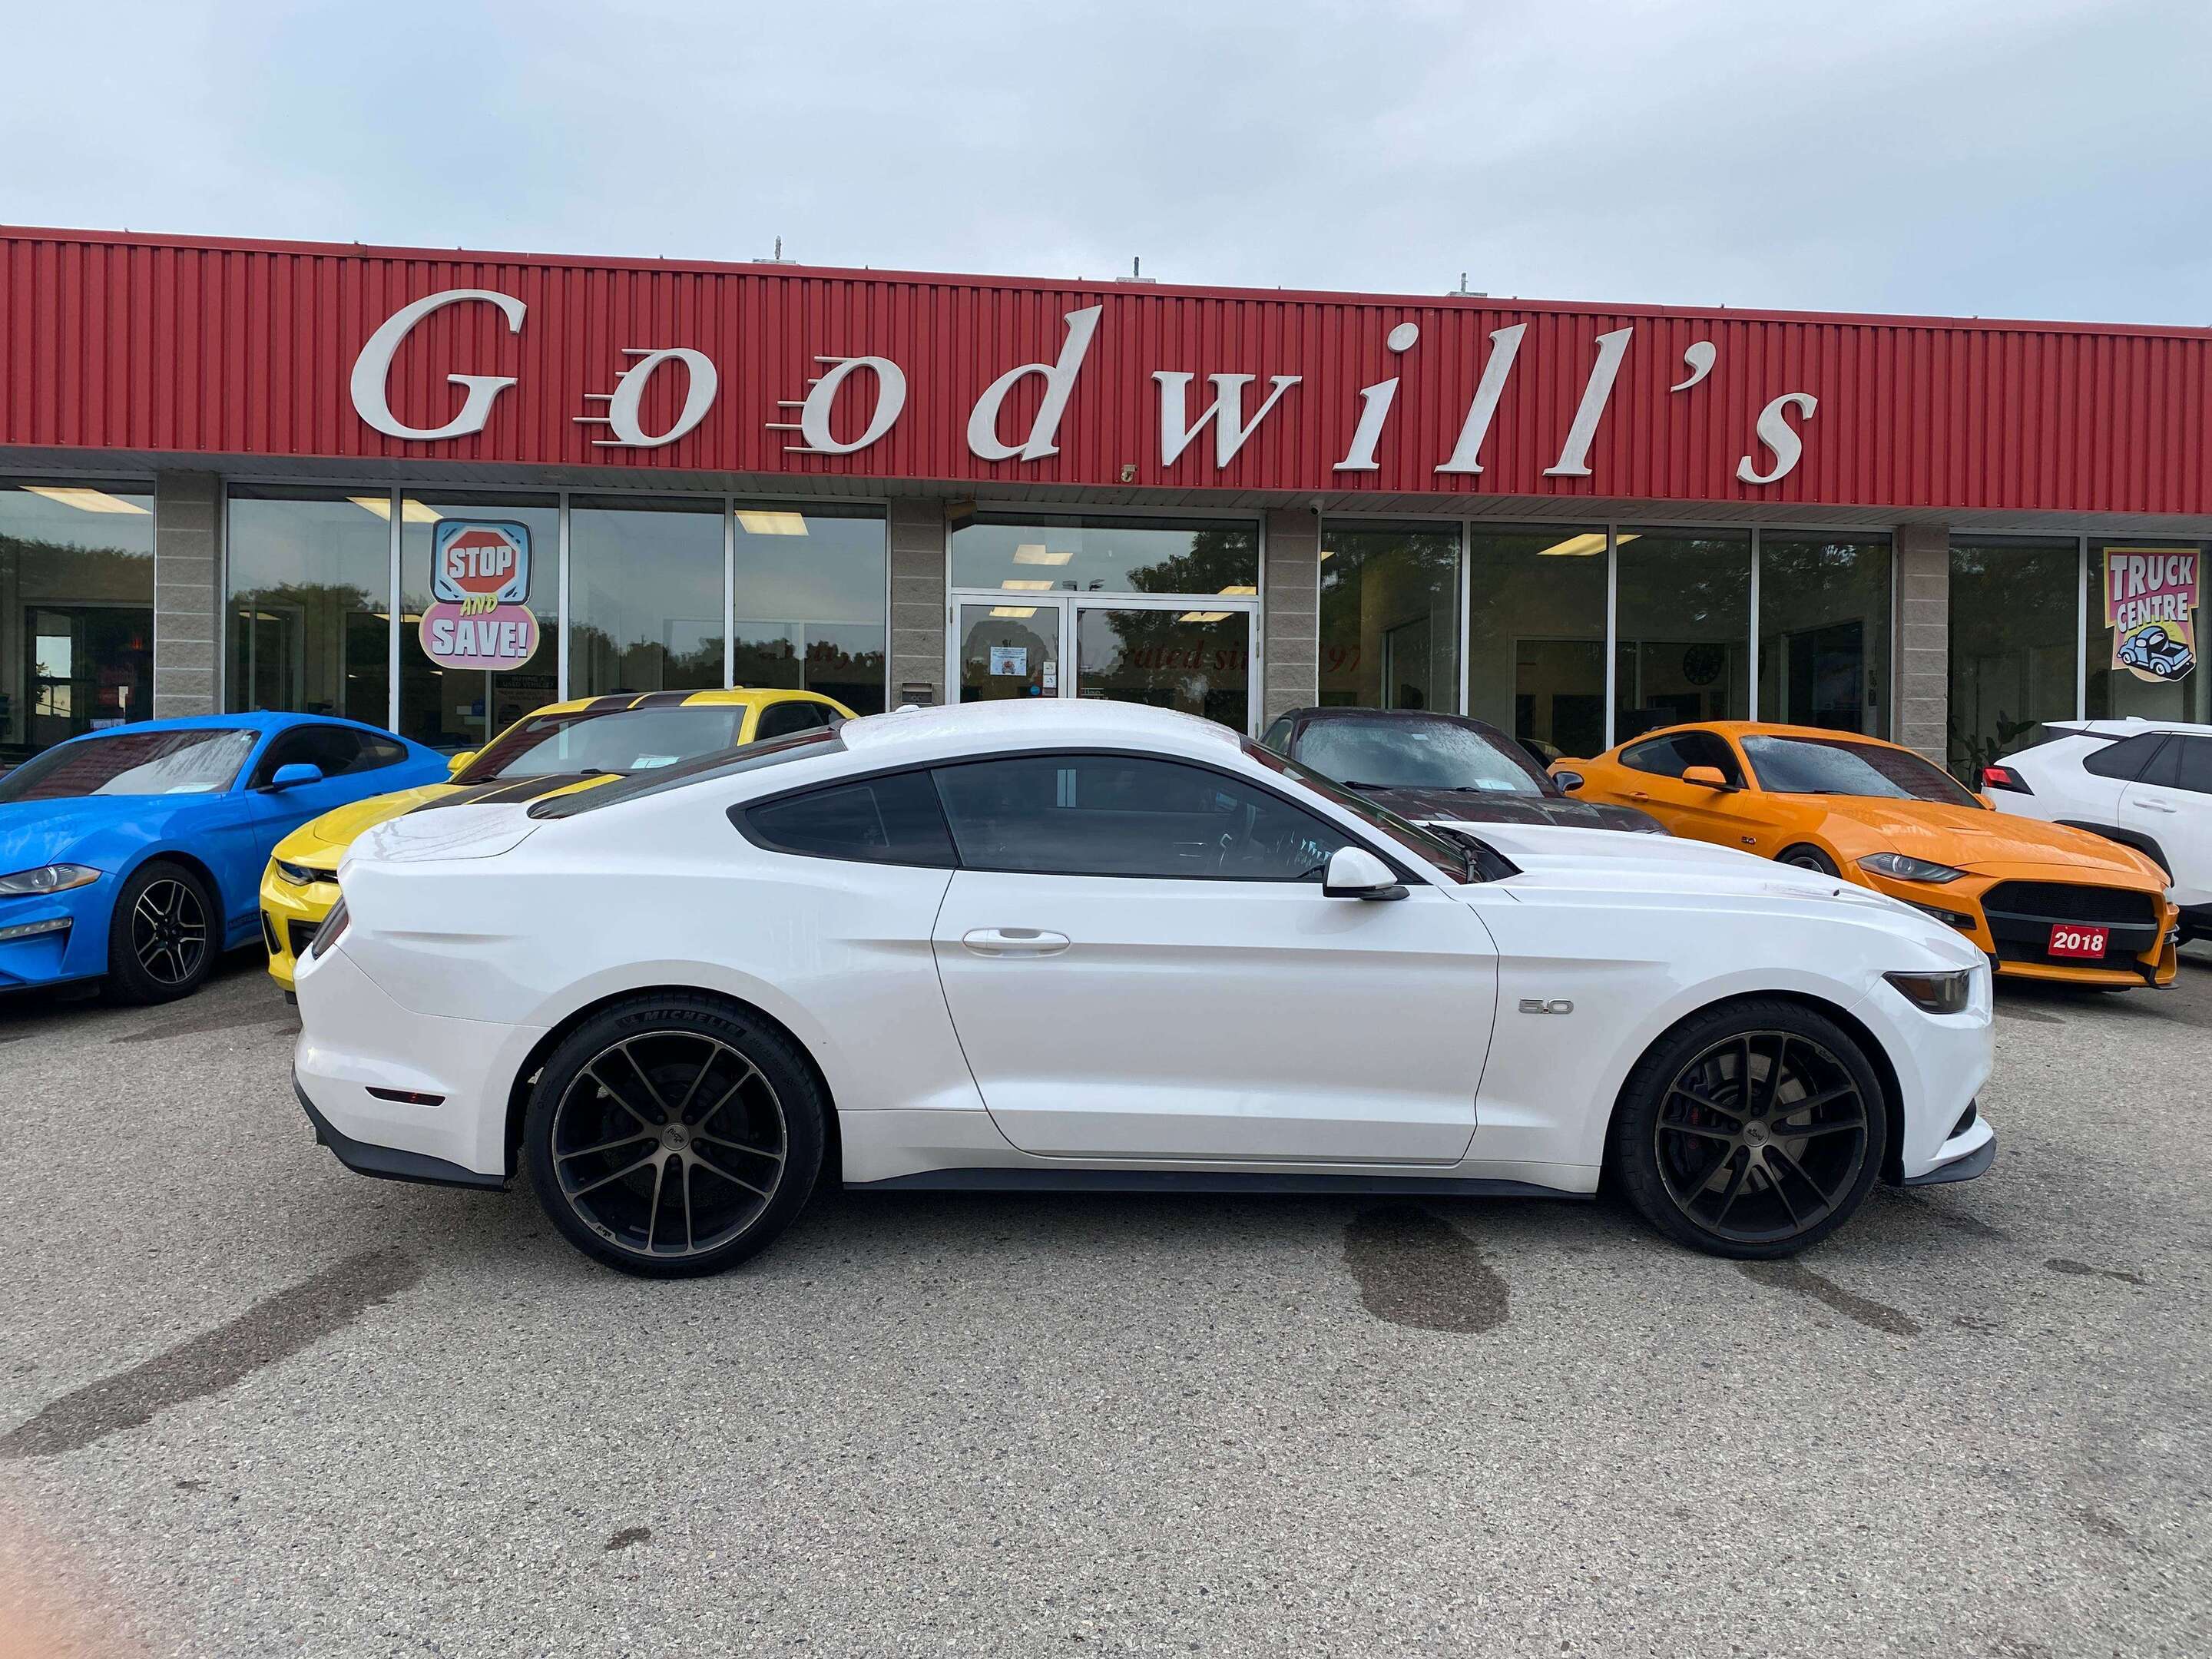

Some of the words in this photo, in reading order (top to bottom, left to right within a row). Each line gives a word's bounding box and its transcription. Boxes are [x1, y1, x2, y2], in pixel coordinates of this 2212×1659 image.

[350, 288, 1819, 485] Goodwill's
[449, 546, 512, 579] STOP
[2111, 555, 2194, 601] TRUCK
[460, 594, 498, 617] AND
[2117, 592, 2188, 633] CENTRE
[432, 619, 528, 658] SAVE!
[2053, 932, 2104, 952] 2018
[644, 1009, 746, 1037] MICHELIN
[1518, 998, 1575, 1015] 5.0
